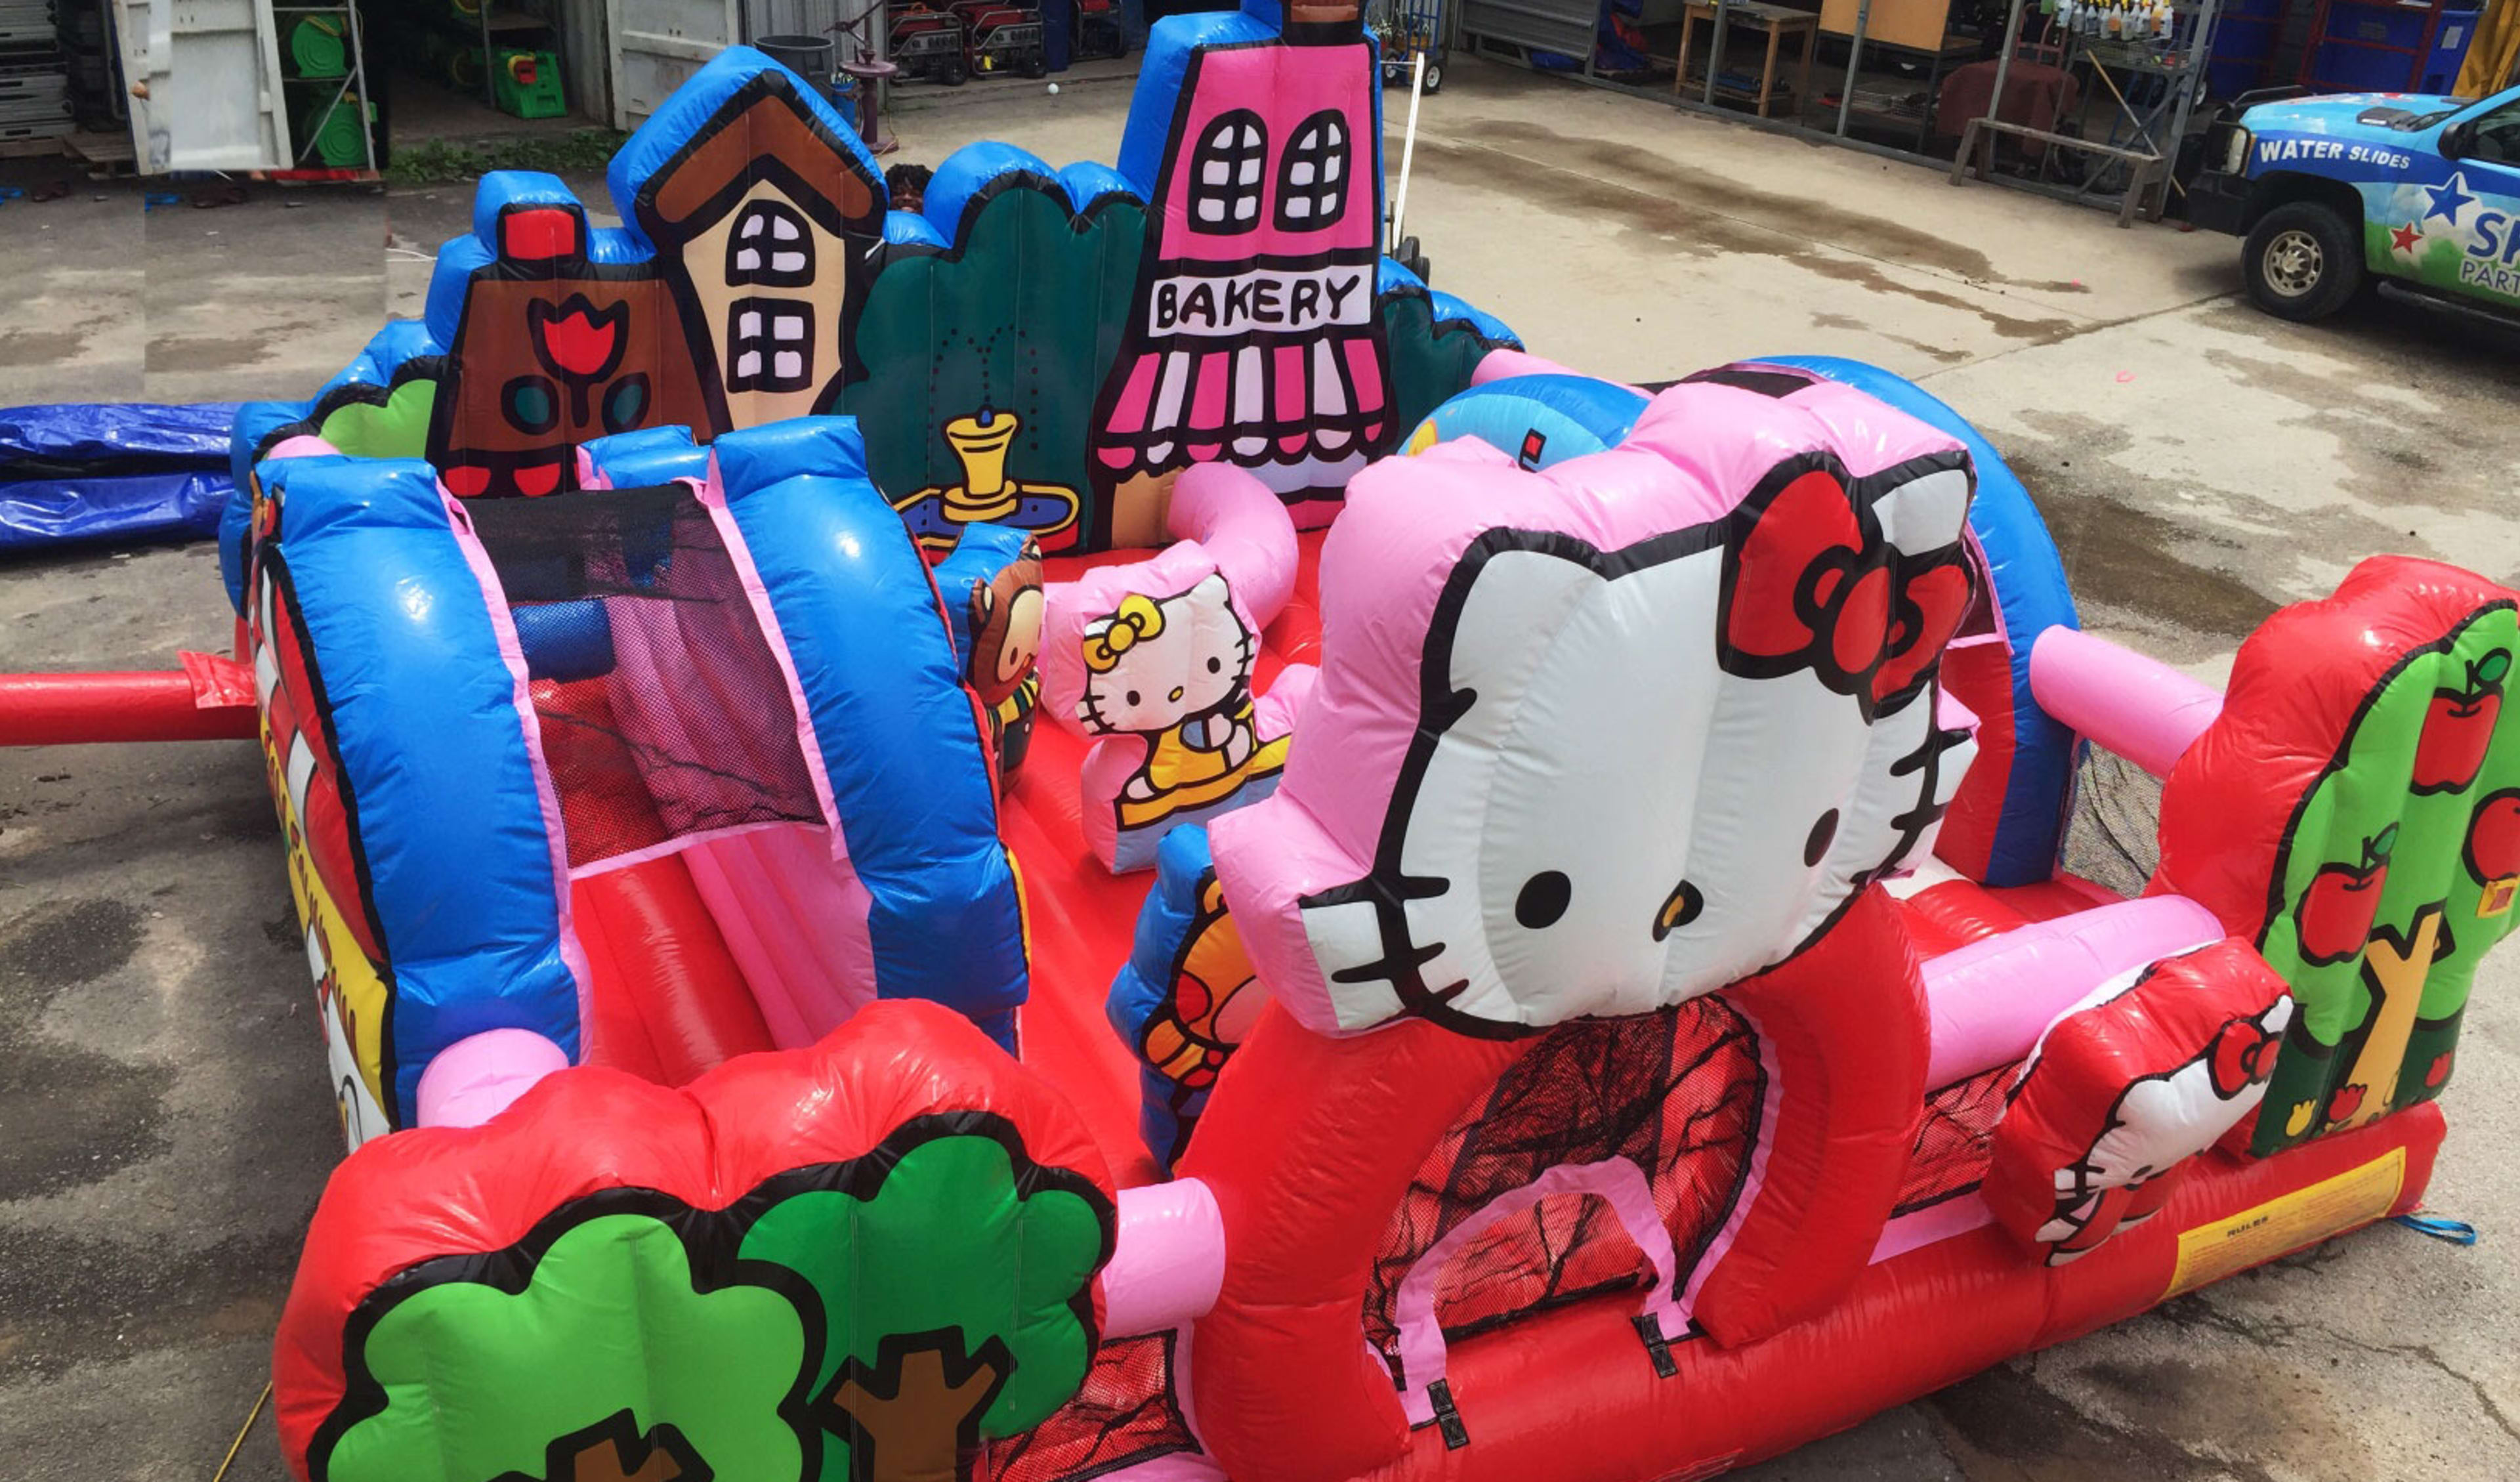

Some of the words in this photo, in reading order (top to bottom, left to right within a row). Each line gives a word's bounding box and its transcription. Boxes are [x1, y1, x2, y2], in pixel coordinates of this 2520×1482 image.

[2260, 139, 2343, 163] WATER
[2348, 146, 2410, 169] SLIDES
[1156, 274, 1360, 328] BAKERY
